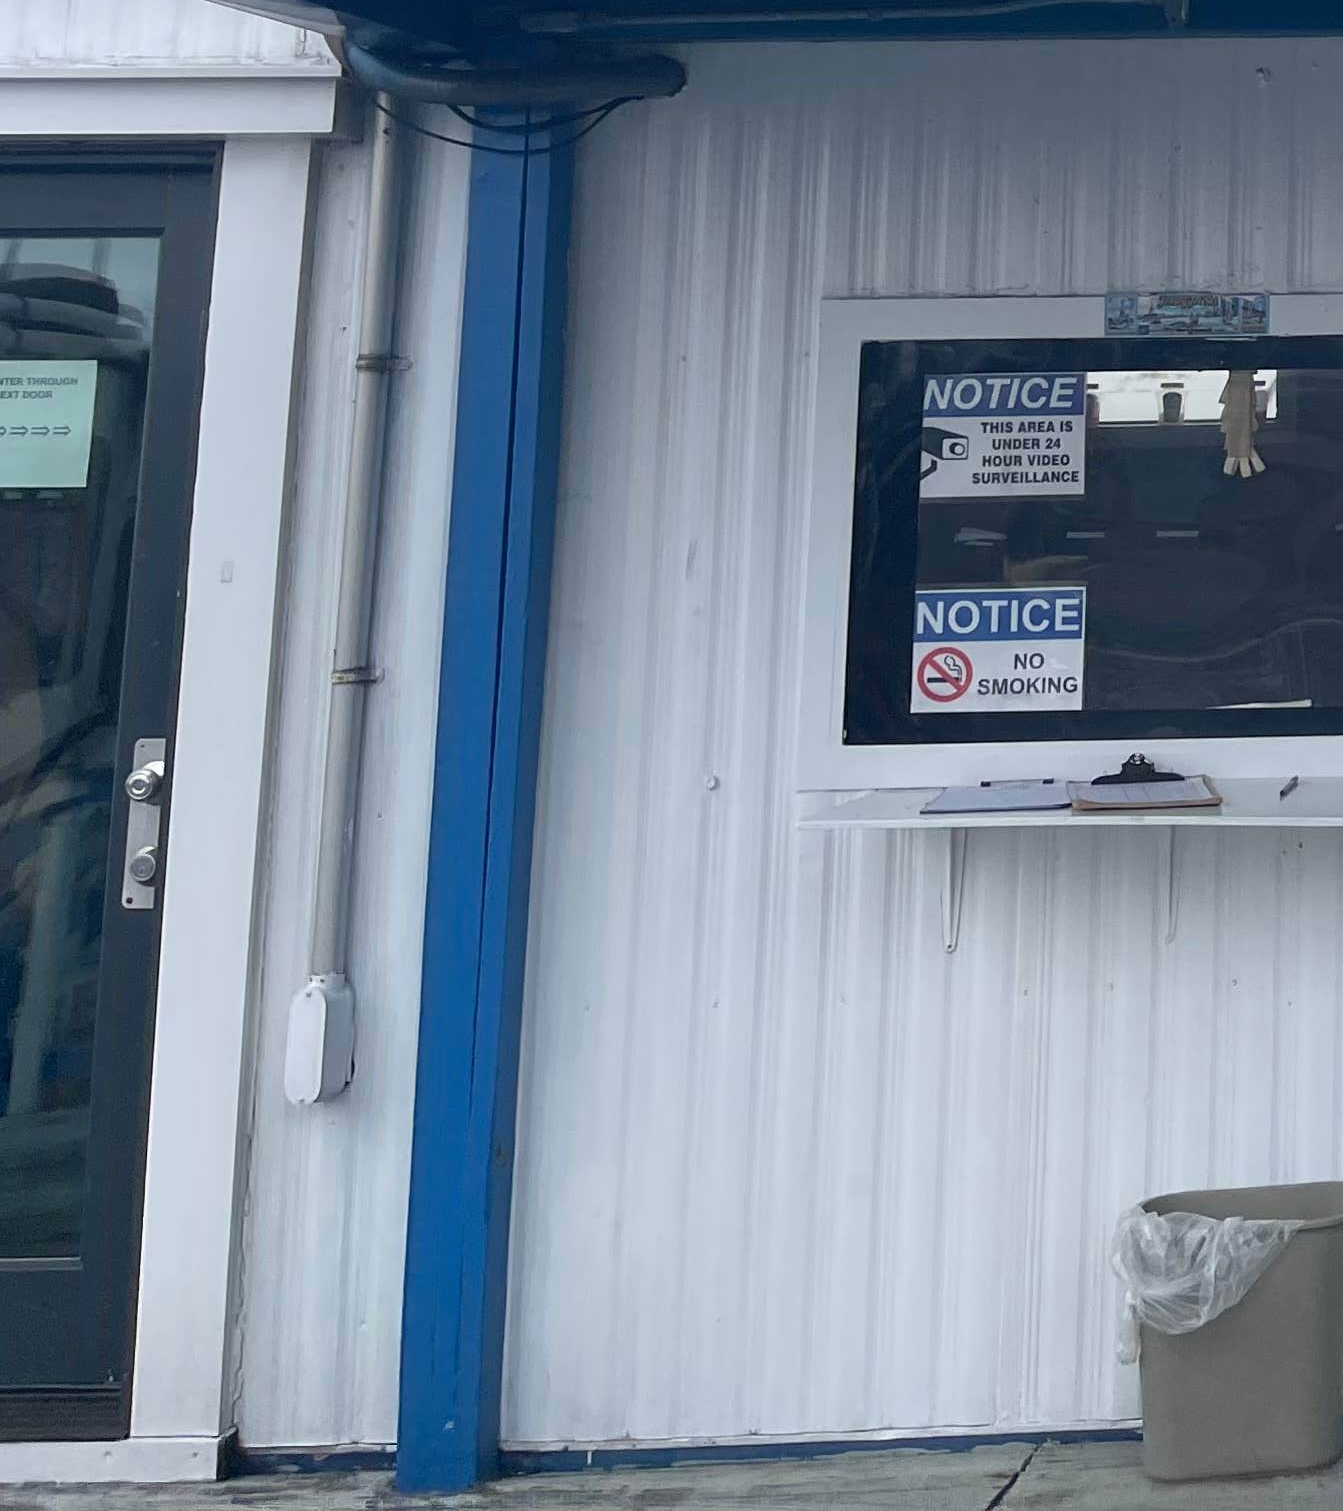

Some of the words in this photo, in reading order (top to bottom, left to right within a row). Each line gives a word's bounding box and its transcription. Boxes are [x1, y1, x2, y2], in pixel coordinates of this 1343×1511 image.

[26, 377, 79, 386] THROUGH
[23, 390, 53, 399] DOOR
[924, 377, 1077, 410] NOTICE
[980, 422, 1013, 434] THIS
[1018, 421, 1055, 433] AREA
[1060, 420, 1073, 432] IS
[992, 439, 1041, 450] UNDER
[1045, 438, 1061, 449] 24
[982, 455, 1022, 467] HOUR
[1027, 454, 1070, 466] VIDEO
[972, 471, 1080, 484] SURVEILLANCE
[916, 598, 1080, 635] NOTICE
[1014, 653, 1045, 670] NO
[978, 677, 1078, 695] SMOKING
